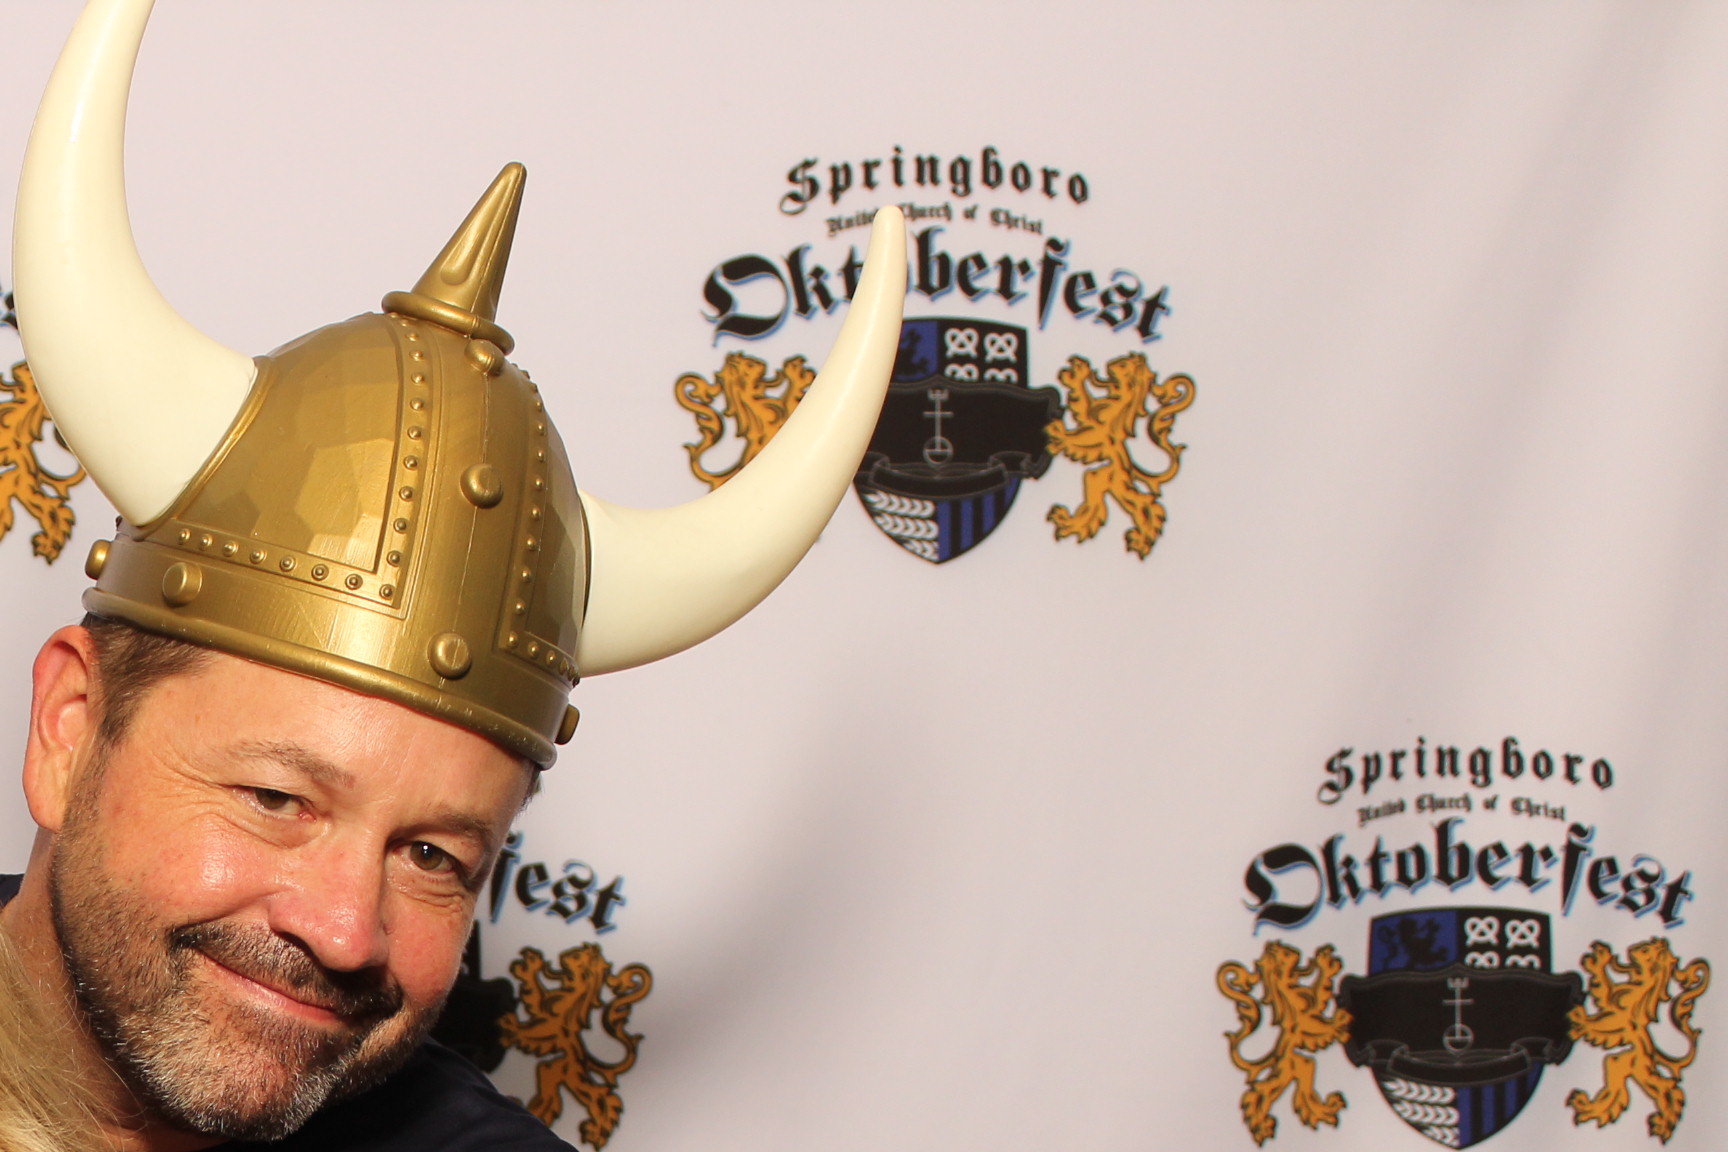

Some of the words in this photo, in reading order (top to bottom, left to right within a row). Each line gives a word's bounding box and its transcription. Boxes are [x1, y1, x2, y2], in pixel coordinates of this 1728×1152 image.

[779, 145, 1089, 214] Springboro
[826, 209, 879, 237] Unite
[699, 225, 1172, 347] Oktberfest
[1317, 736, 1613, 805] Springboro
[1357, 799, 1405, 827] United
[1416, 793, 1471, 815] Church
[1483, 794, 1498, 811] of
[1511, 797, 1565, 820] Christ
[1241, 817, 1694, 935] Oktoberfest
